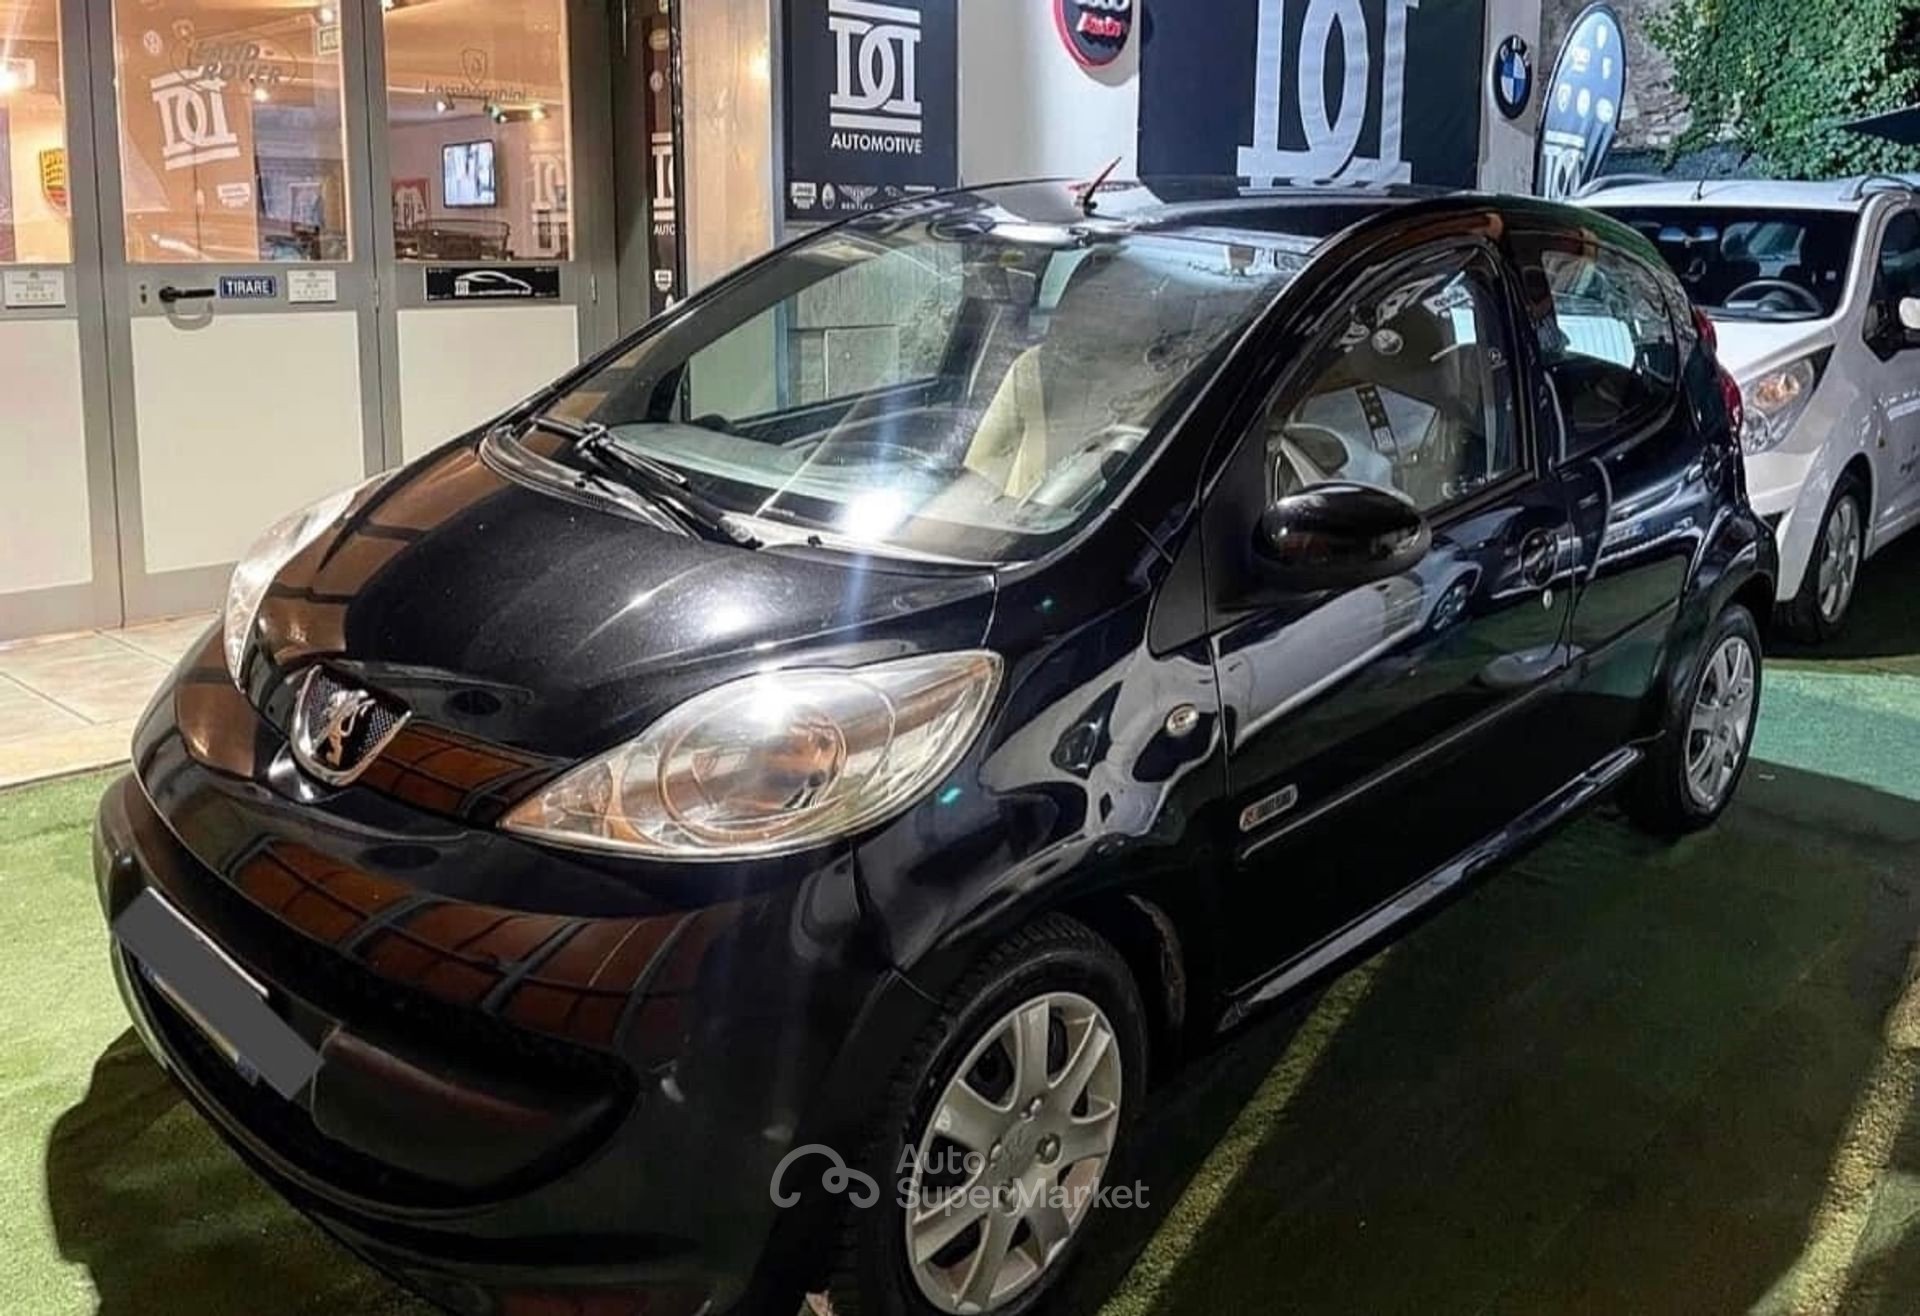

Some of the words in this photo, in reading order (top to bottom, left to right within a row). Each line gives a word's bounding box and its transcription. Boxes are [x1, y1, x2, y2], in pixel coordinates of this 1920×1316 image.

[203, 62, 283, 84] ROVER
[831, 132, 922, 154] AUTOMOTIVE
[225, 279, 271, 294] TIRARE
